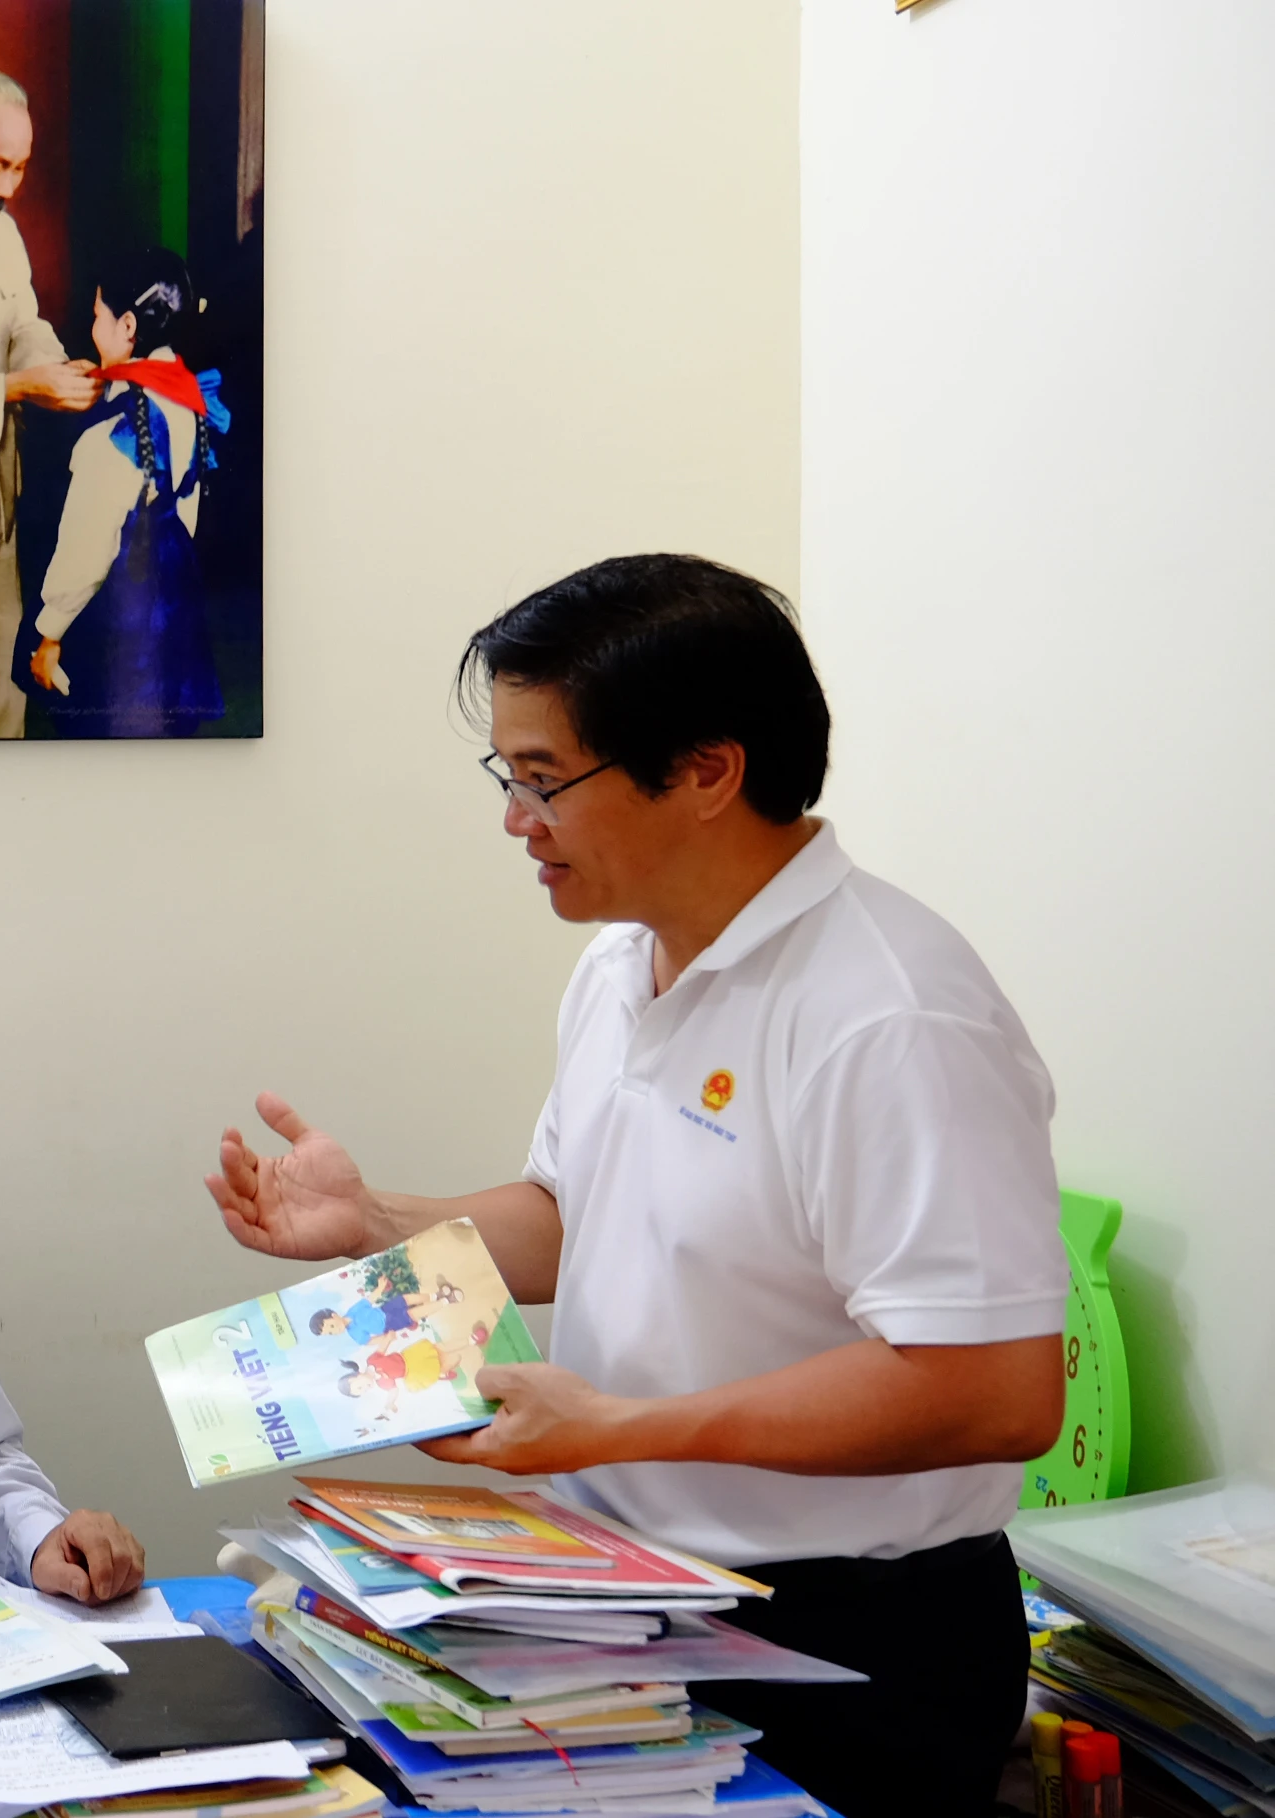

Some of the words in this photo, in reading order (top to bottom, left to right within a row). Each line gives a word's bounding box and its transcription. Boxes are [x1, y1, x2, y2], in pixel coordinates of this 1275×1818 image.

[212, 1319, 254, 1347] 2
[1088, 1340, 1098, 1352] 40
[232, 1348, 273, 1401] VIỆT
[1067, 1336, 1081, 1380] 8
[255, 1400, 302, 1461] TIẾNG
[1072, 1424, 1087, 1468] 9
[1094, 1449, 1103, 1462] 45
[1035, 1474, 1049, 1493] 22
